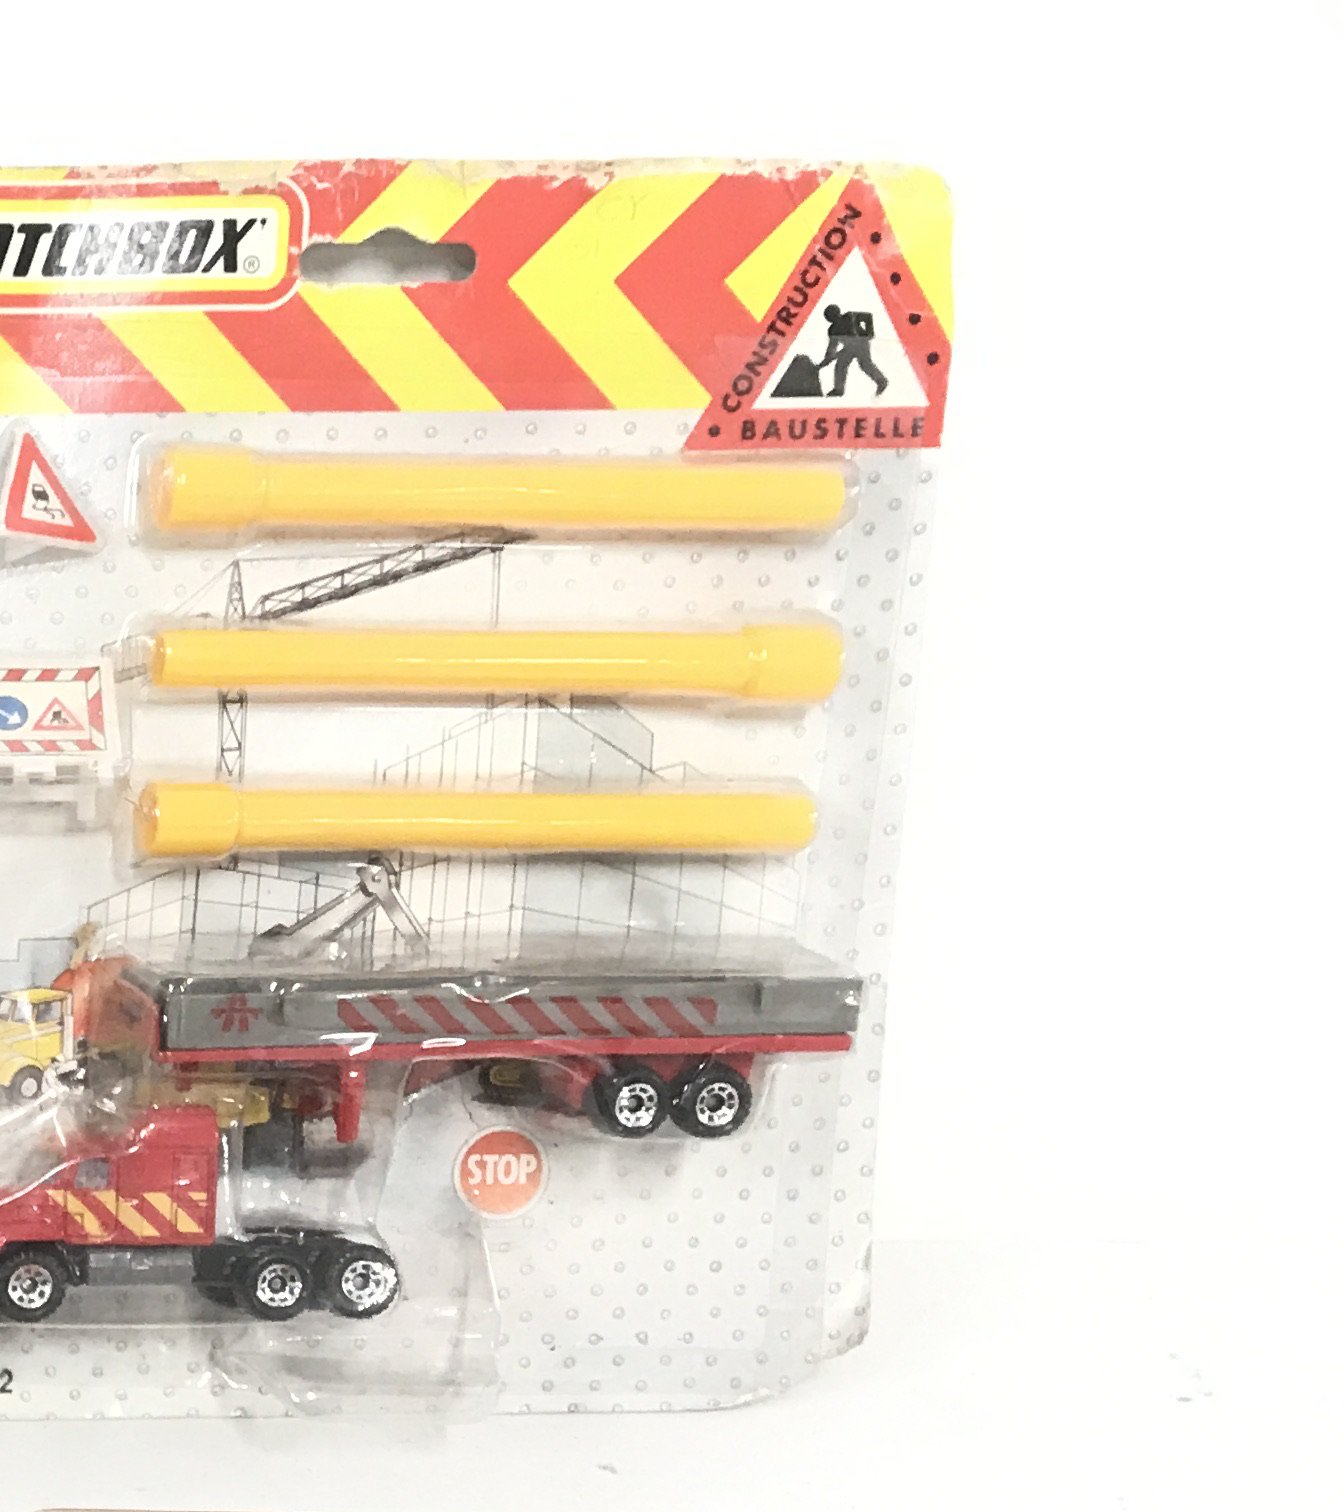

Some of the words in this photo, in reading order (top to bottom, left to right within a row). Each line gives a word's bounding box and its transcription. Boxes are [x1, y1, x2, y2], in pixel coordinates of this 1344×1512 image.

[721, 202, 863, 413] CONSTRUCTION
[740, 416, 927, 441] BAUSTELLE
[466, 1152, 539, 1186] STOP
